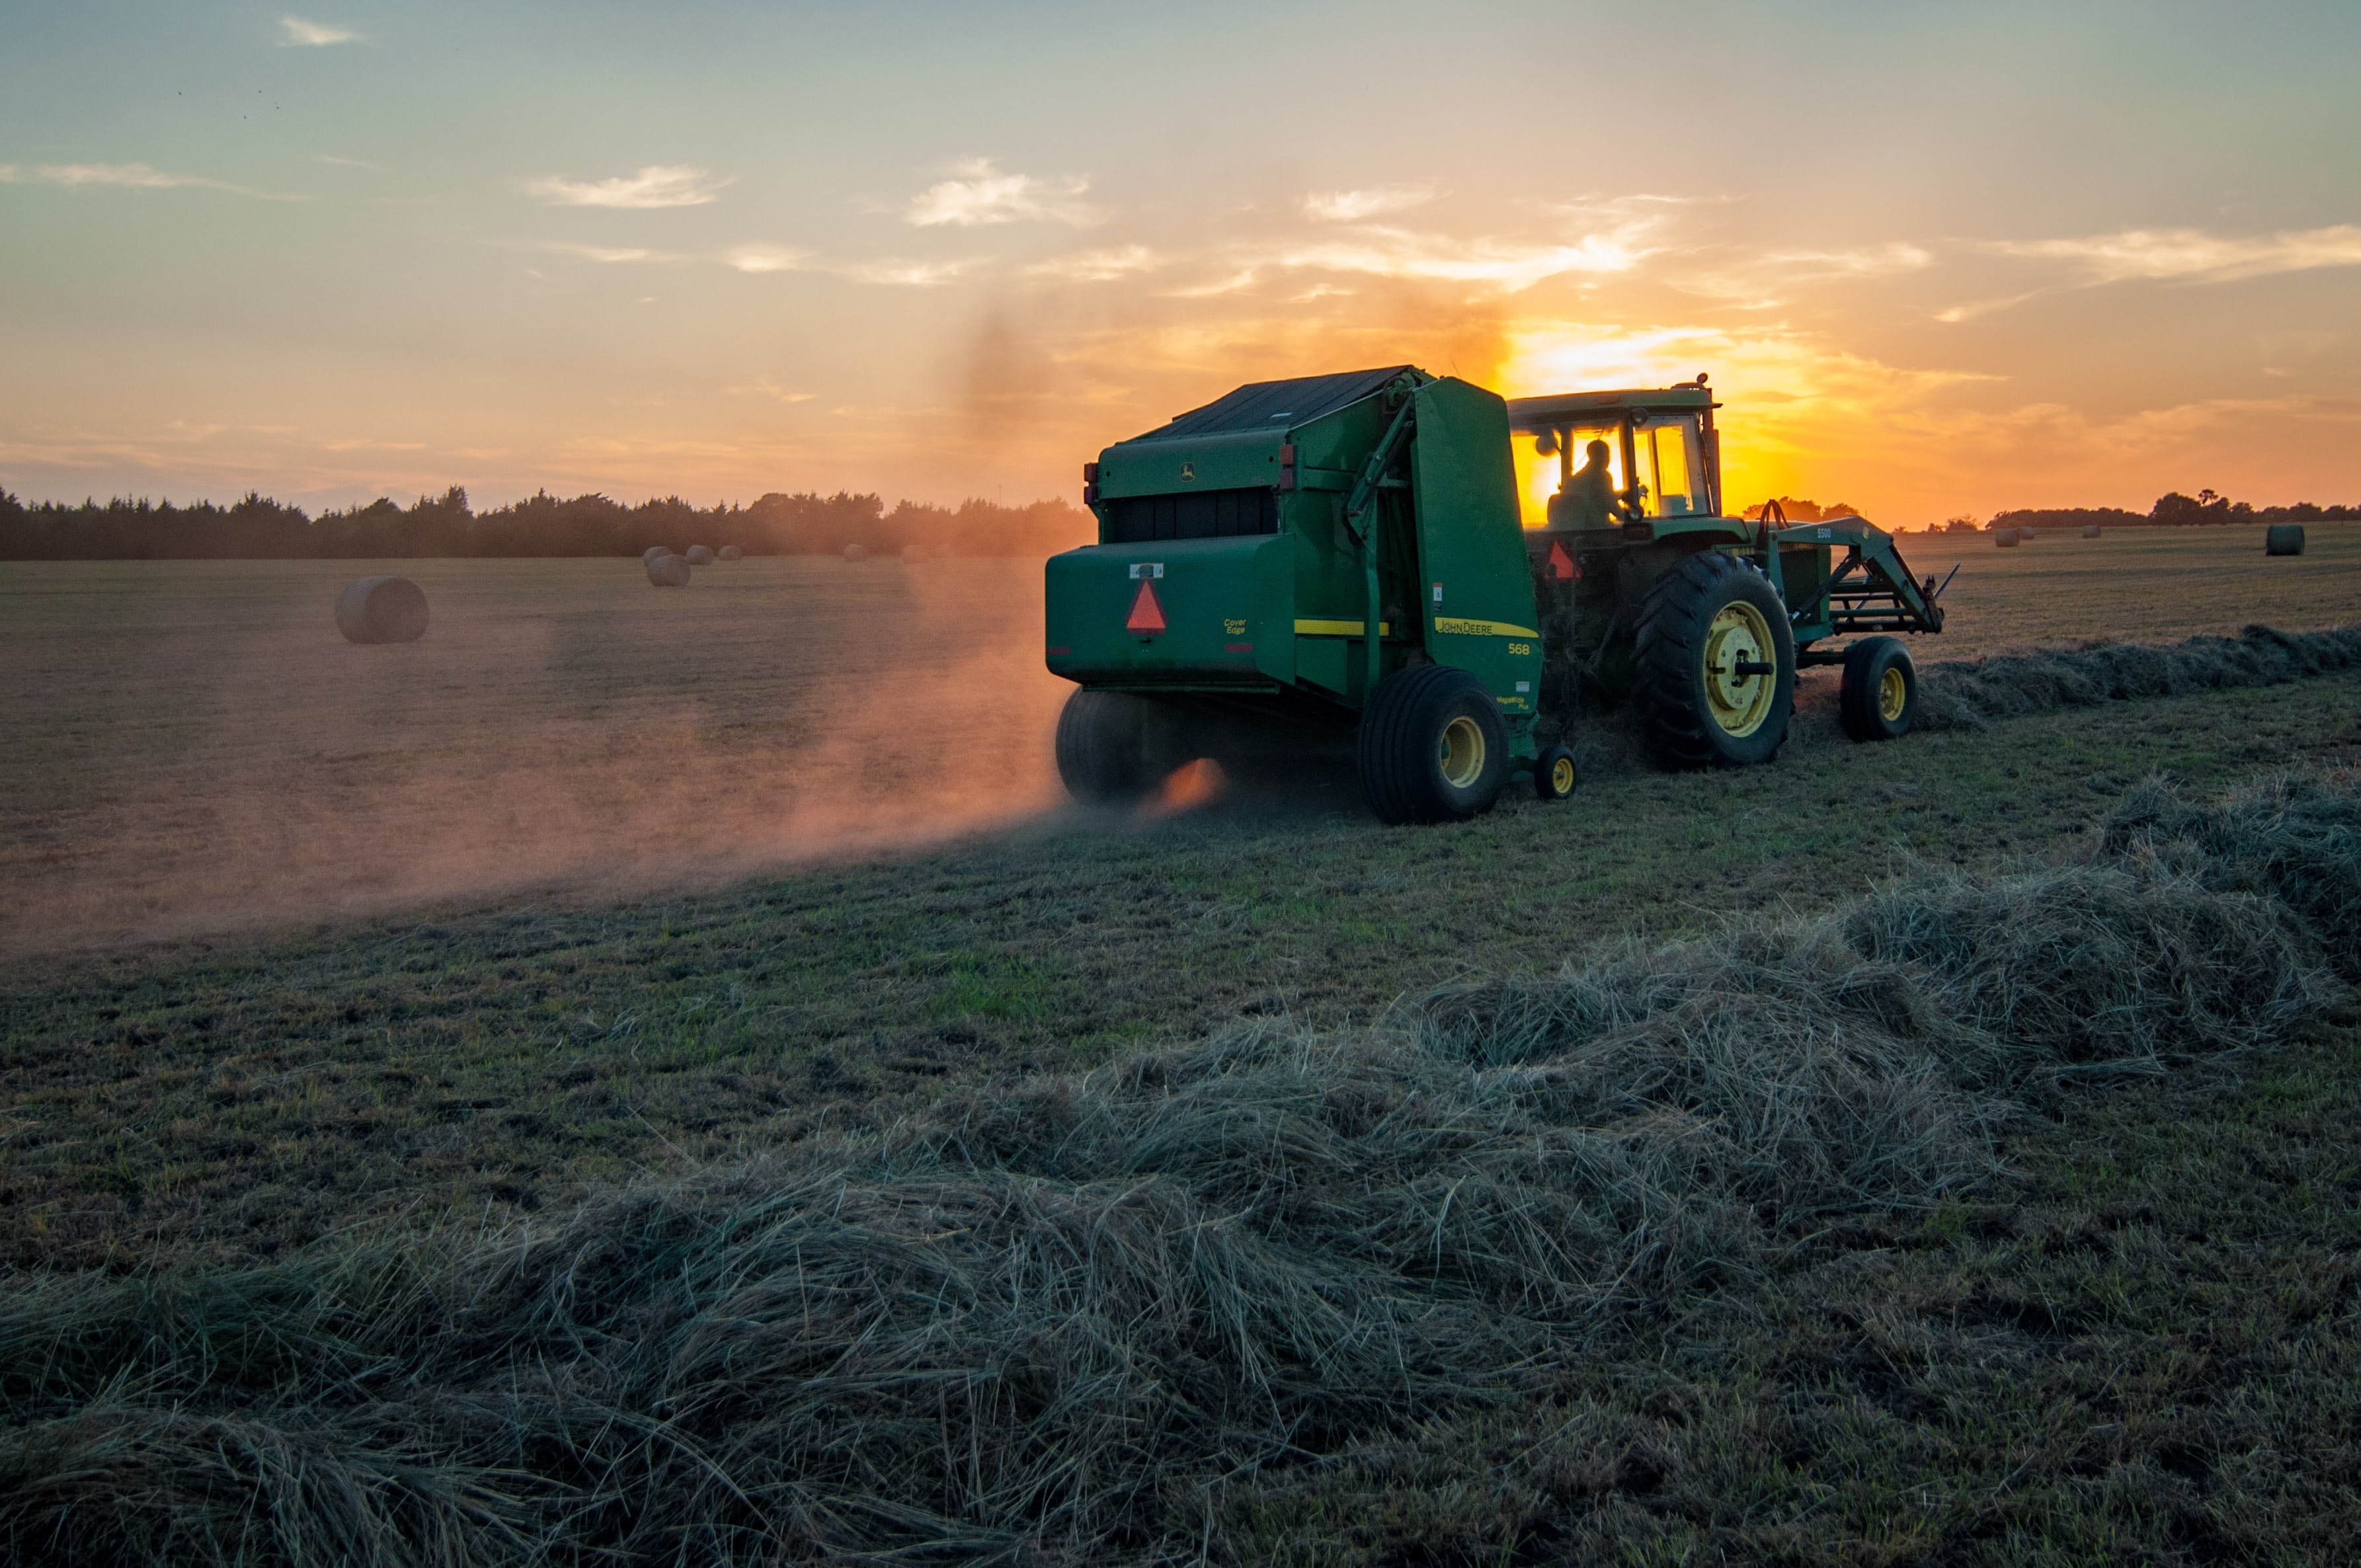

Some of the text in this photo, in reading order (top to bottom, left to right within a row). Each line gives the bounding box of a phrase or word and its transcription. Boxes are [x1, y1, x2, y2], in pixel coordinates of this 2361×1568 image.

[1818, 528, 1831, 539] 5500
[1226, 626, 1246, 635] Edge
[1439, 621, 1492, 634] JOHN DEERE
[1509, 643, 1529, 655] 568
